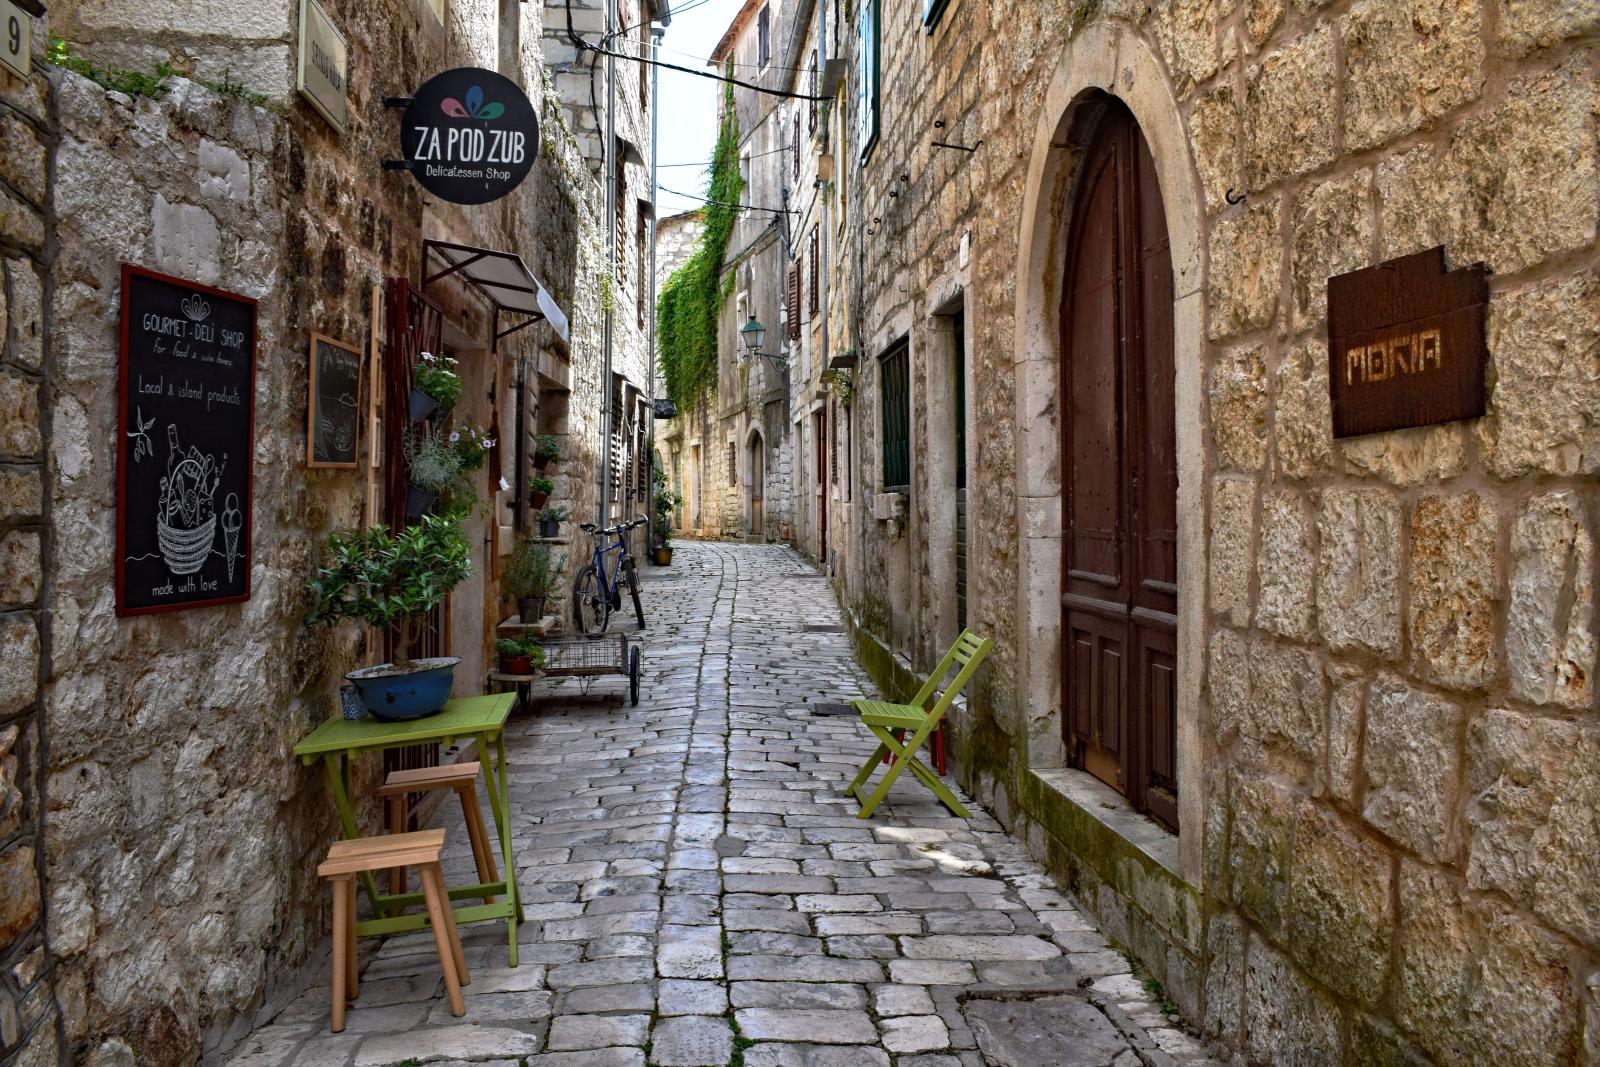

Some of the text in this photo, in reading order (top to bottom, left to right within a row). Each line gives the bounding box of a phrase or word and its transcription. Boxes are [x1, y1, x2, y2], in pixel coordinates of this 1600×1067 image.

[8, 15, 20, 56] 9
[414, 126, 526, 164] ZA POD ZUB
[426, 164, 511, 182] Delicatessen Shop
[143, 313, 187, 338] GOURMET
[220, 329, 244, 349] SHOP
[172, 340, 190, 358] food
[1346, 328, 1441, 386] MORIA
[139, 374, 241, 412] Local & island products
[152, 574, 218, 597] made with love
